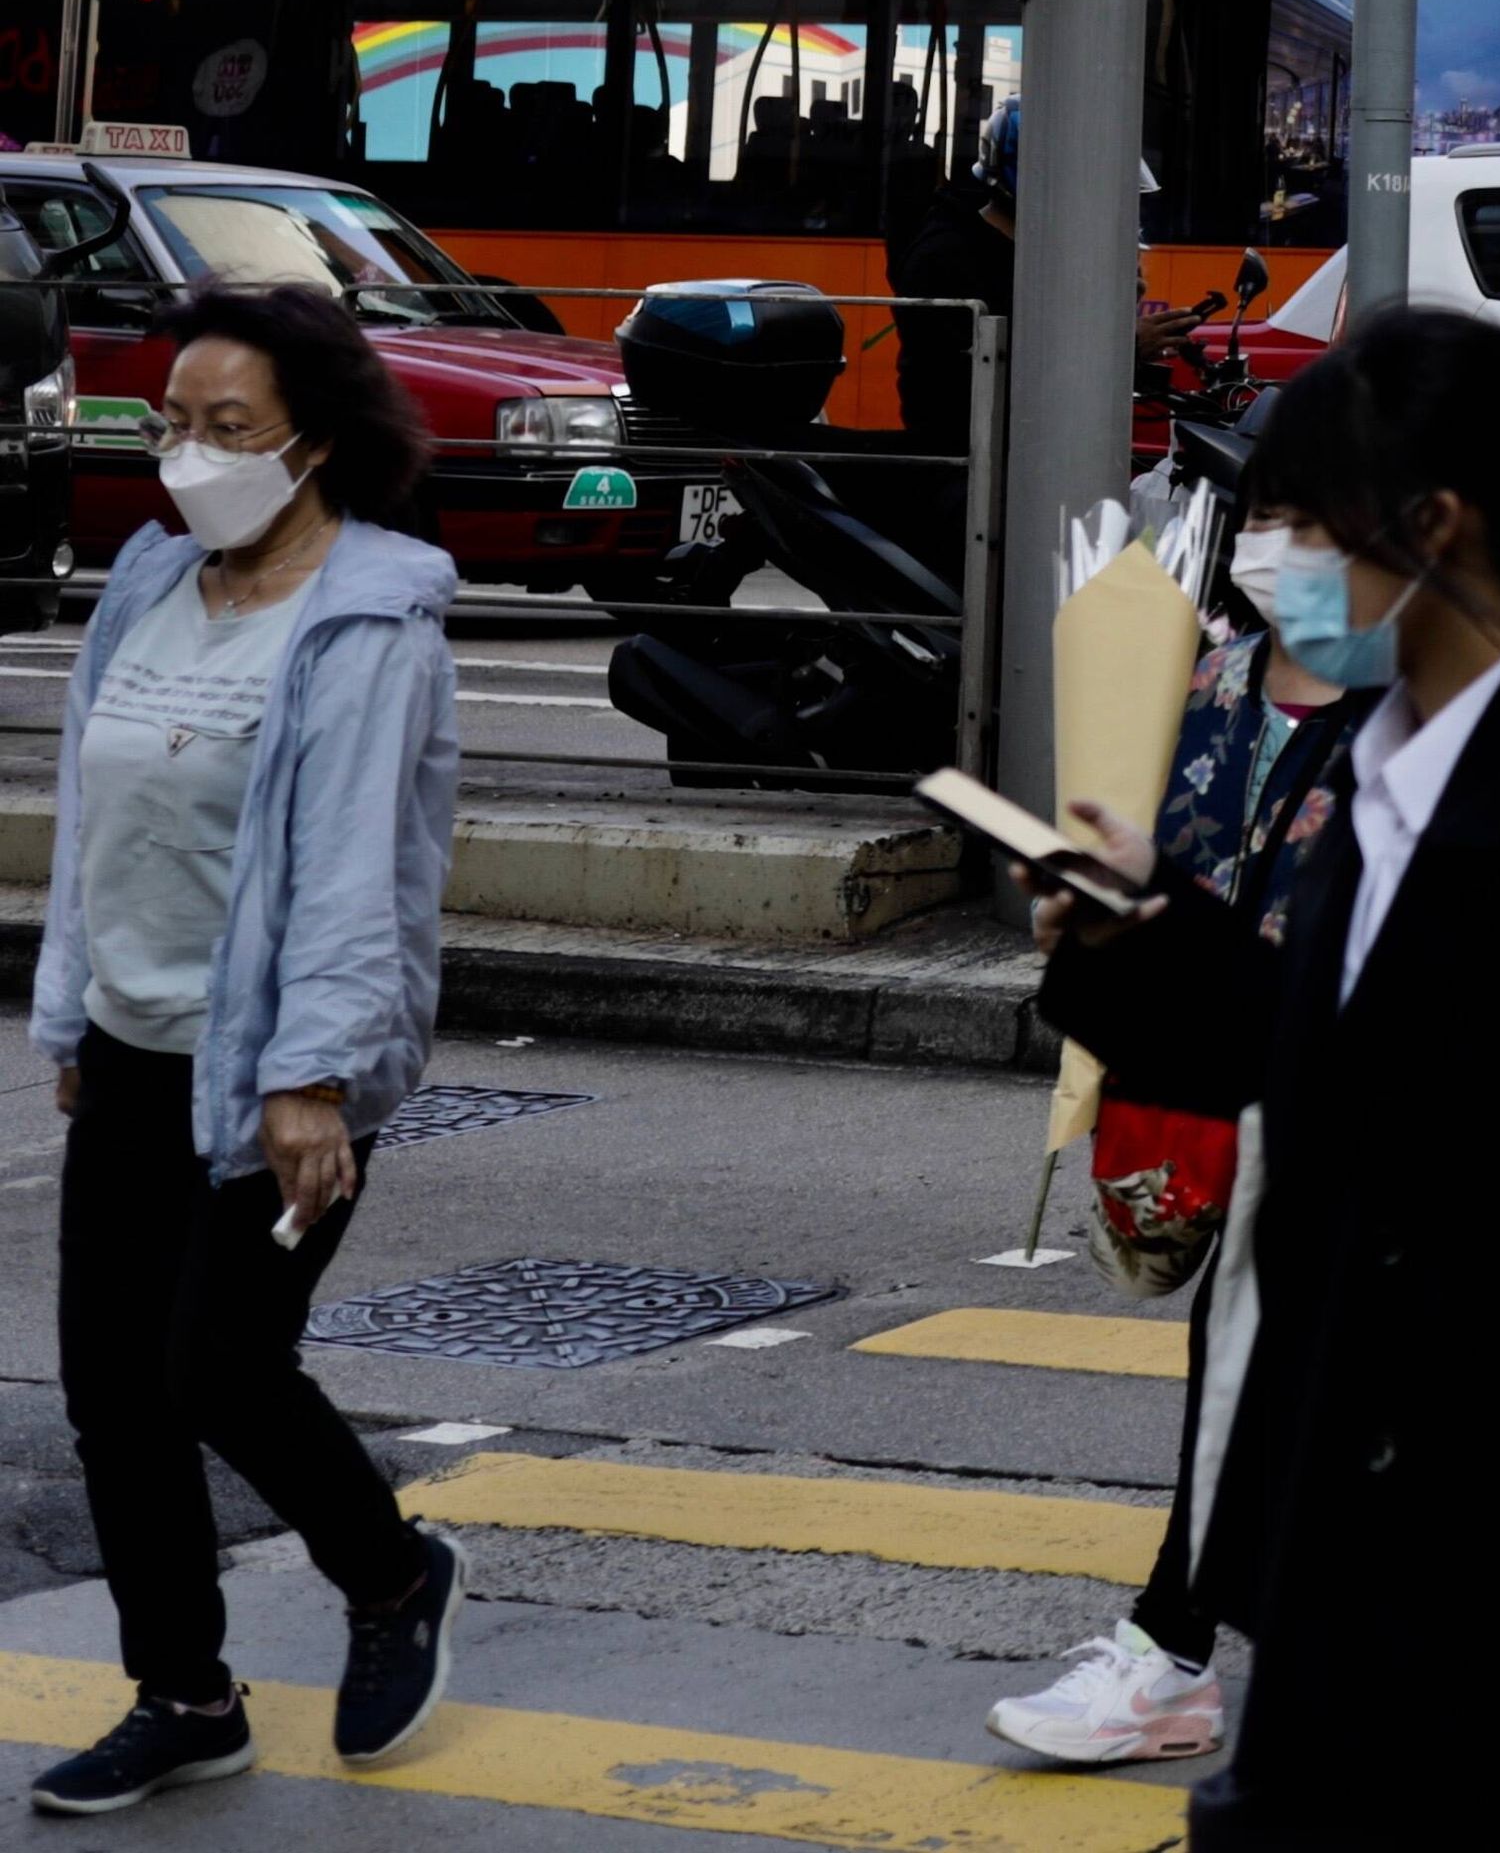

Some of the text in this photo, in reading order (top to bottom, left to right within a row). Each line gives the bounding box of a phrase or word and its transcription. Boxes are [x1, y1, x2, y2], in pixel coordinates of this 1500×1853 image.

[105, 127, 184, 152] TAXI
[596, 475, 611, 495] 4
[580, 495, 623, 506] SEATS
[702, 487, 727, 514] DF
[690, 514, 728, 542] 76
